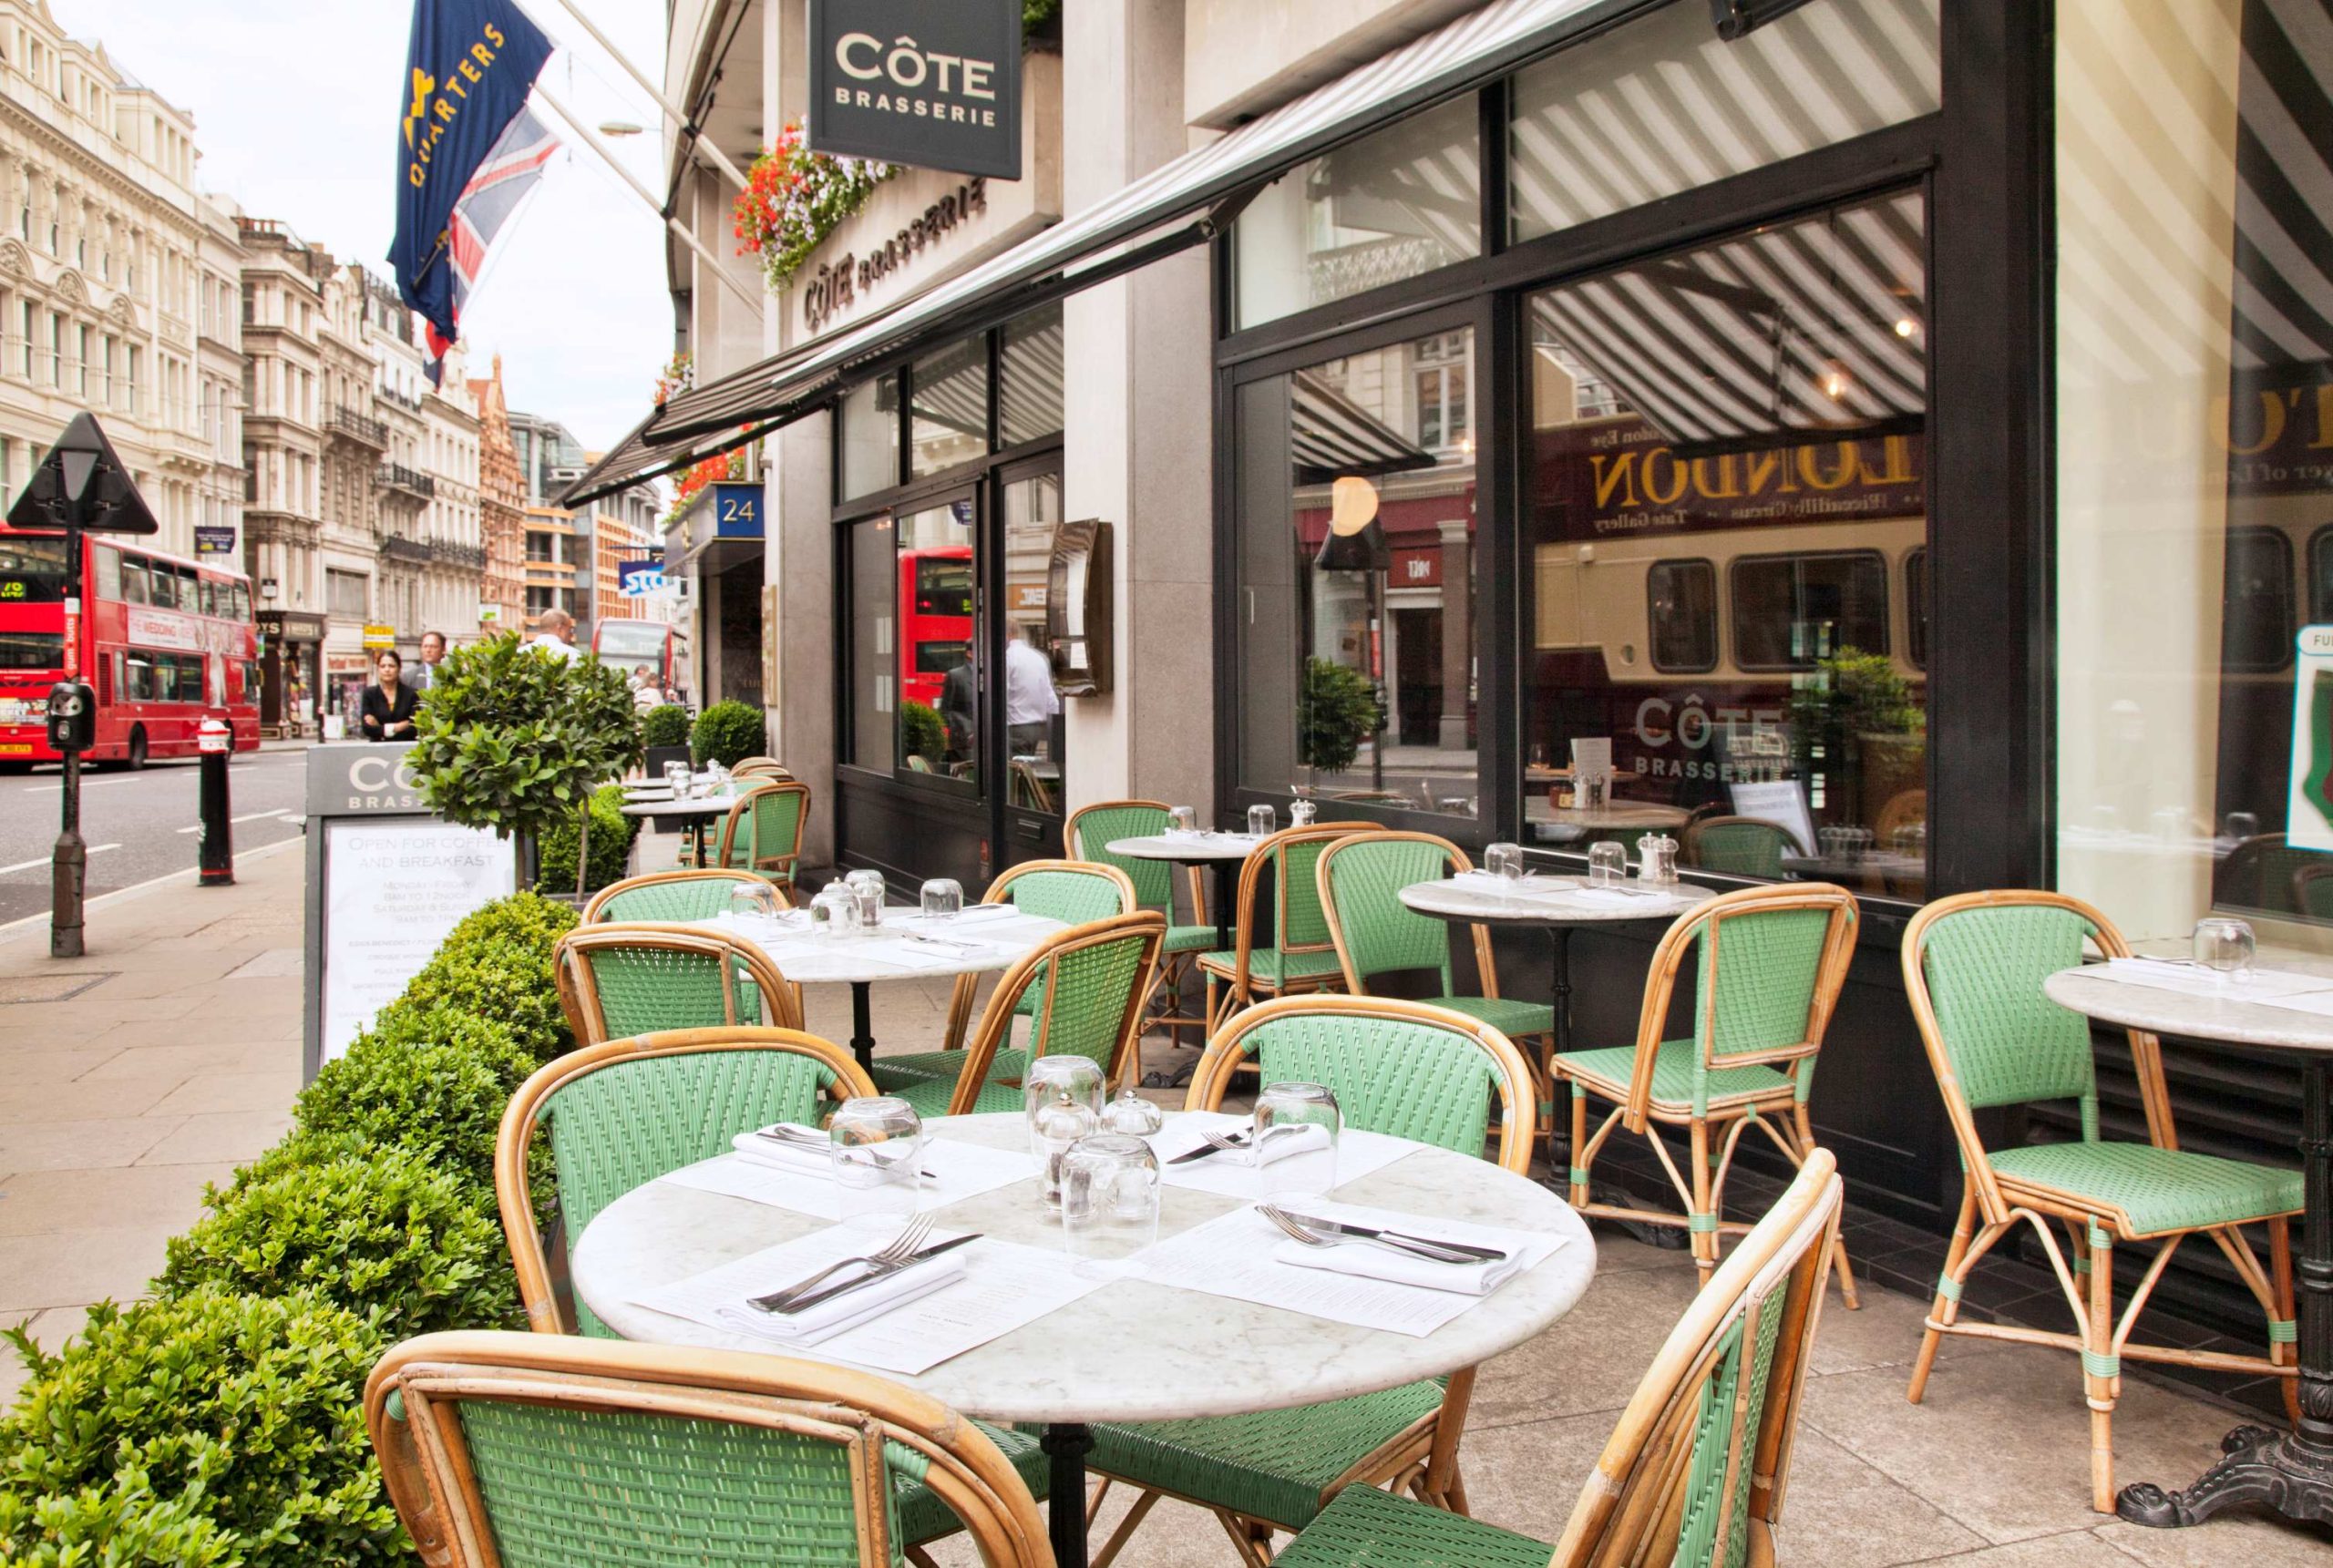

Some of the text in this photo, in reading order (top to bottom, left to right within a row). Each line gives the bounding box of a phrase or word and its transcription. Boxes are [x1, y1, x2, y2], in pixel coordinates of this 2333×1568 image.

[836, 33, 995, 101] CÔTE
[409, 22, 505, 188] QUARTERS
[836, 87, 995, 127] BRASSERIE
[858, 177, 987, 292] BRASSERIE
[723, 498, 755, 522] 24
[66, 617, 75, 642] butts
[1636, 693, 1783, 755] CÔTE
[1635, 756, 1783, 784] BRASSERIE
[402, 837, 436, 849] FOR
[359, 855, 495, 868] AND BREAKFAST
